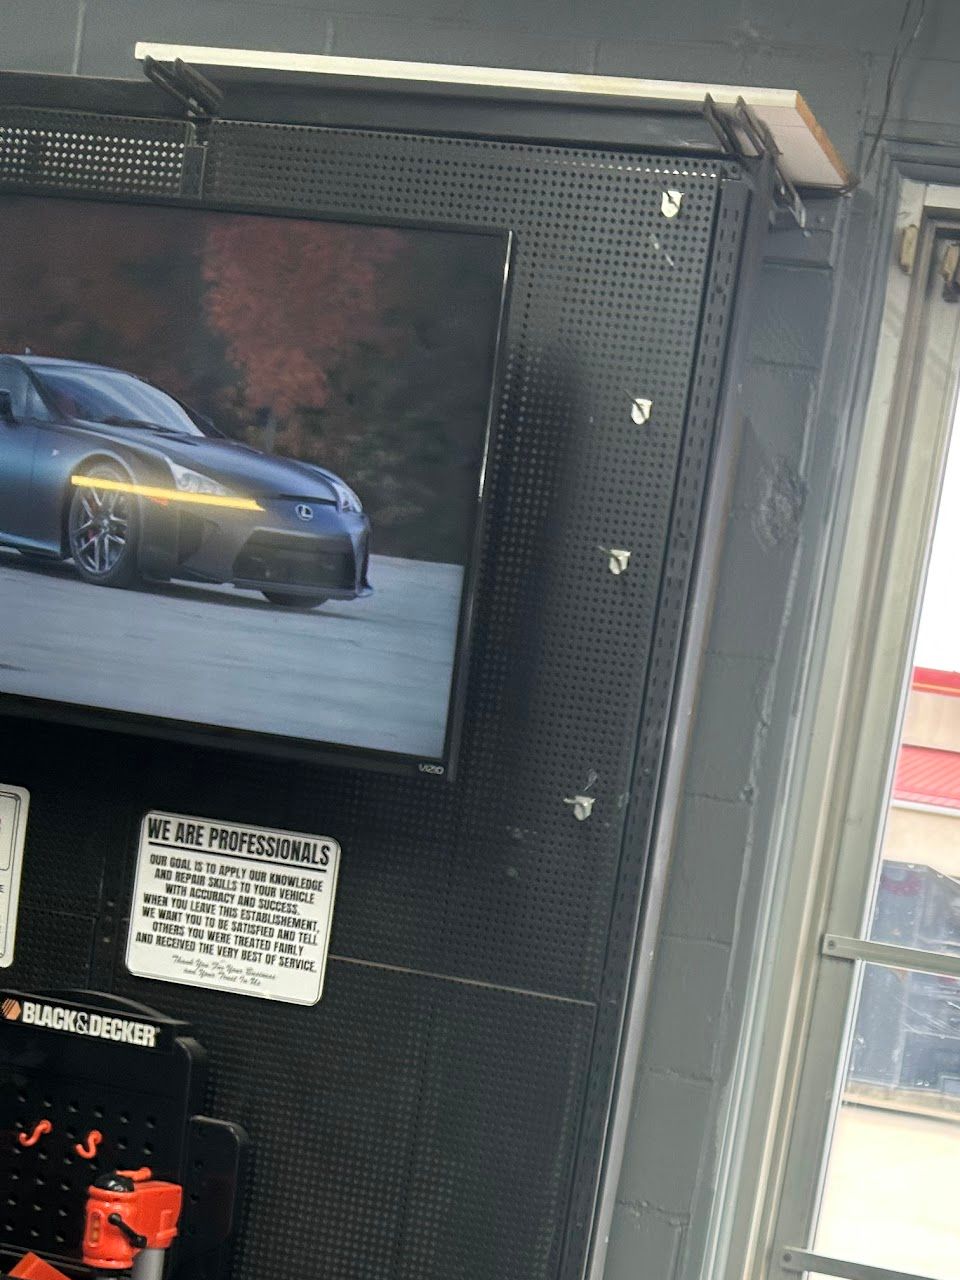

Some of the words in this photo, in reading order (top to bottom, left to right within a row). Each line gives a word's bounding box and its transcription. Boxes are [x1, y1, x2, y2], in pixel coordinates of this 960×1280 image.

[418, 763, 444, 775] VIZIO
[148, 817, 171, 840] WE
[174, 823, 204, 845] ARE
[208, 827, 329, 866] PROFESSIONALS
[150, 854, 168, 866] OUR
[170, 856, 191, 869] GOAL
[194, 862, 203, 872] IS
[206, 863, 216, 873] TO
[219, 864, 247, 879] APPLY
[249, 870, 266, 881] OUR
[270, 873, 323, 892] KNOWLEDGE
[154, 868, 172, 880] AND
[175, 873, 205, 886] REPAIR
[208, 877, 237, 891] SKILLS
[240, 882, 251, 893] TO
[254, 885, 276, 897] YOUR
[280, 888, 315, 904] VEHICLE
[143, 893, 168, 906] WHEN
[171, 898, 188, 910] YOU
[190, 900, 215, 915] LEAVE
[219, 906, 238, 918] THIS
[165, 883, 187, 896] WITH
[190, 888, 234, 904] ACCURACY
[238, 896, 255, 907] AND
[259, 899, 300, 915] SUCCESS.
[142, 906, 155, 918] WE
[158, 909, 182, 921] WANT
[185, 913, 201, 926] YOU
[205, 917, 215, 928] TO
[218, 920, 228, 930] BE
[232, 922, 274, 938] SATISFIED
[277, 929, 295, 941] AND
[299, 932, 318, 945] TELL
[153, 921, 185, 936] OTHERS
[188, 927, 204, 939] YOU
[207, 931, 230, 945] WERE
[234, 936, 271, 950] TREATED
[274, 942, 304, 956] FAIRLY
[136, 932, 153, 944] AND
[156, 936, 195, 951] RECEIVED
[199, 943, 214, 955] THE
[217, 945, 238, 959] VERY
[242, 951, 262, 962] BEST
[265, 954, 275, 965] OF
[279, 956, 317, 972] SERVICE.
[172, 955, 193, 964] Thank
[195, 959, 208, 970] You
[212, 962, 224, 970] For
[227, 964, 242, 972] Your
[246, 967, 275, 979] Business
[199, 969, 215, 978] Your
[219, 972, 236, 982] Trust
[250, 977, 261, 986] Us
[22, 1001, 157, 1048] BLACK&DECKER
